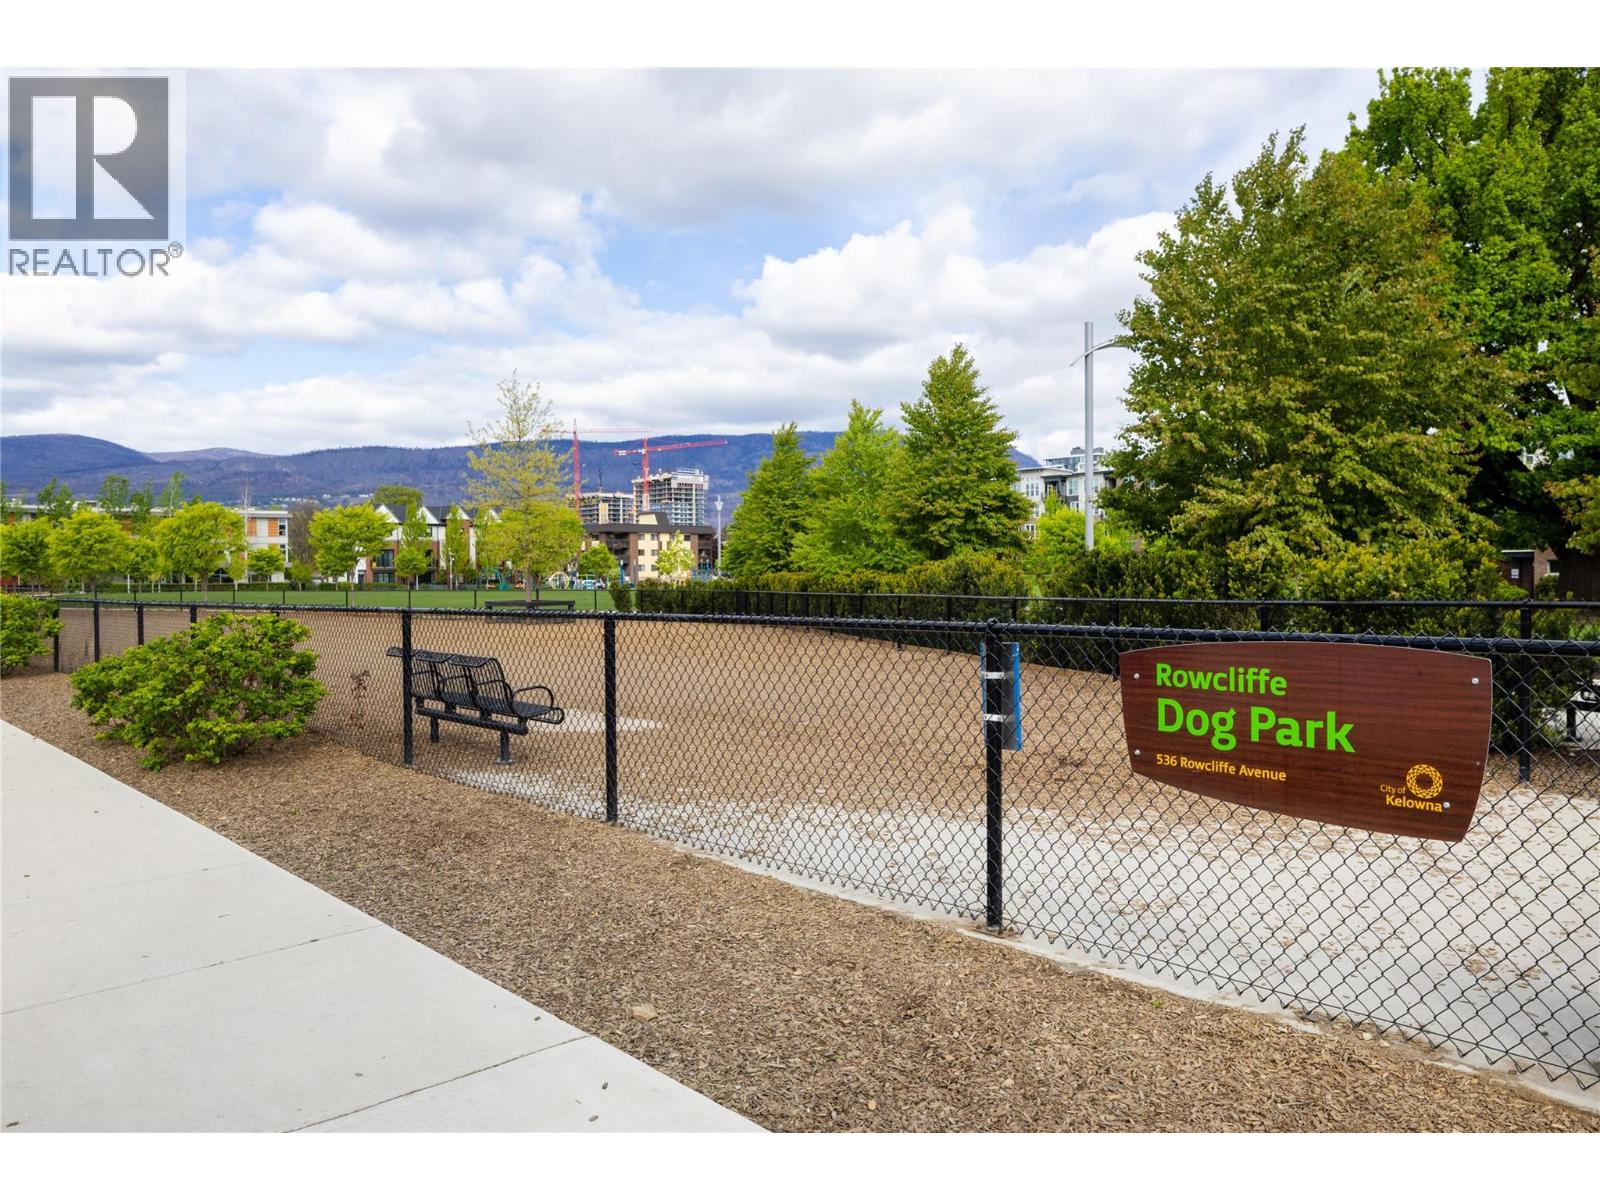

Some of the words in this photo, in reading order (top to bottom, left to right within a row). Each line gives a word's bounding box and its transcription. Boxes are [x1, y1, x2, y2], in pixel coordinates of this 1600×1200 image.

[1156, 662, 1288, 697] Rowcliffe
[1157, 697, 1237, 752] Dog
[1250, 705, 1356, 753] Park
[1156, 753, 1178, 767] 536
[1180, 756, 1236, 775] Rowcliffe
[1239, 764, 1287, 782] Avenue
[1380, 784, 1396, 794] City
[1397, 786, 1406, 794] of
[1385, 794, 1443, 813] Kelowna
